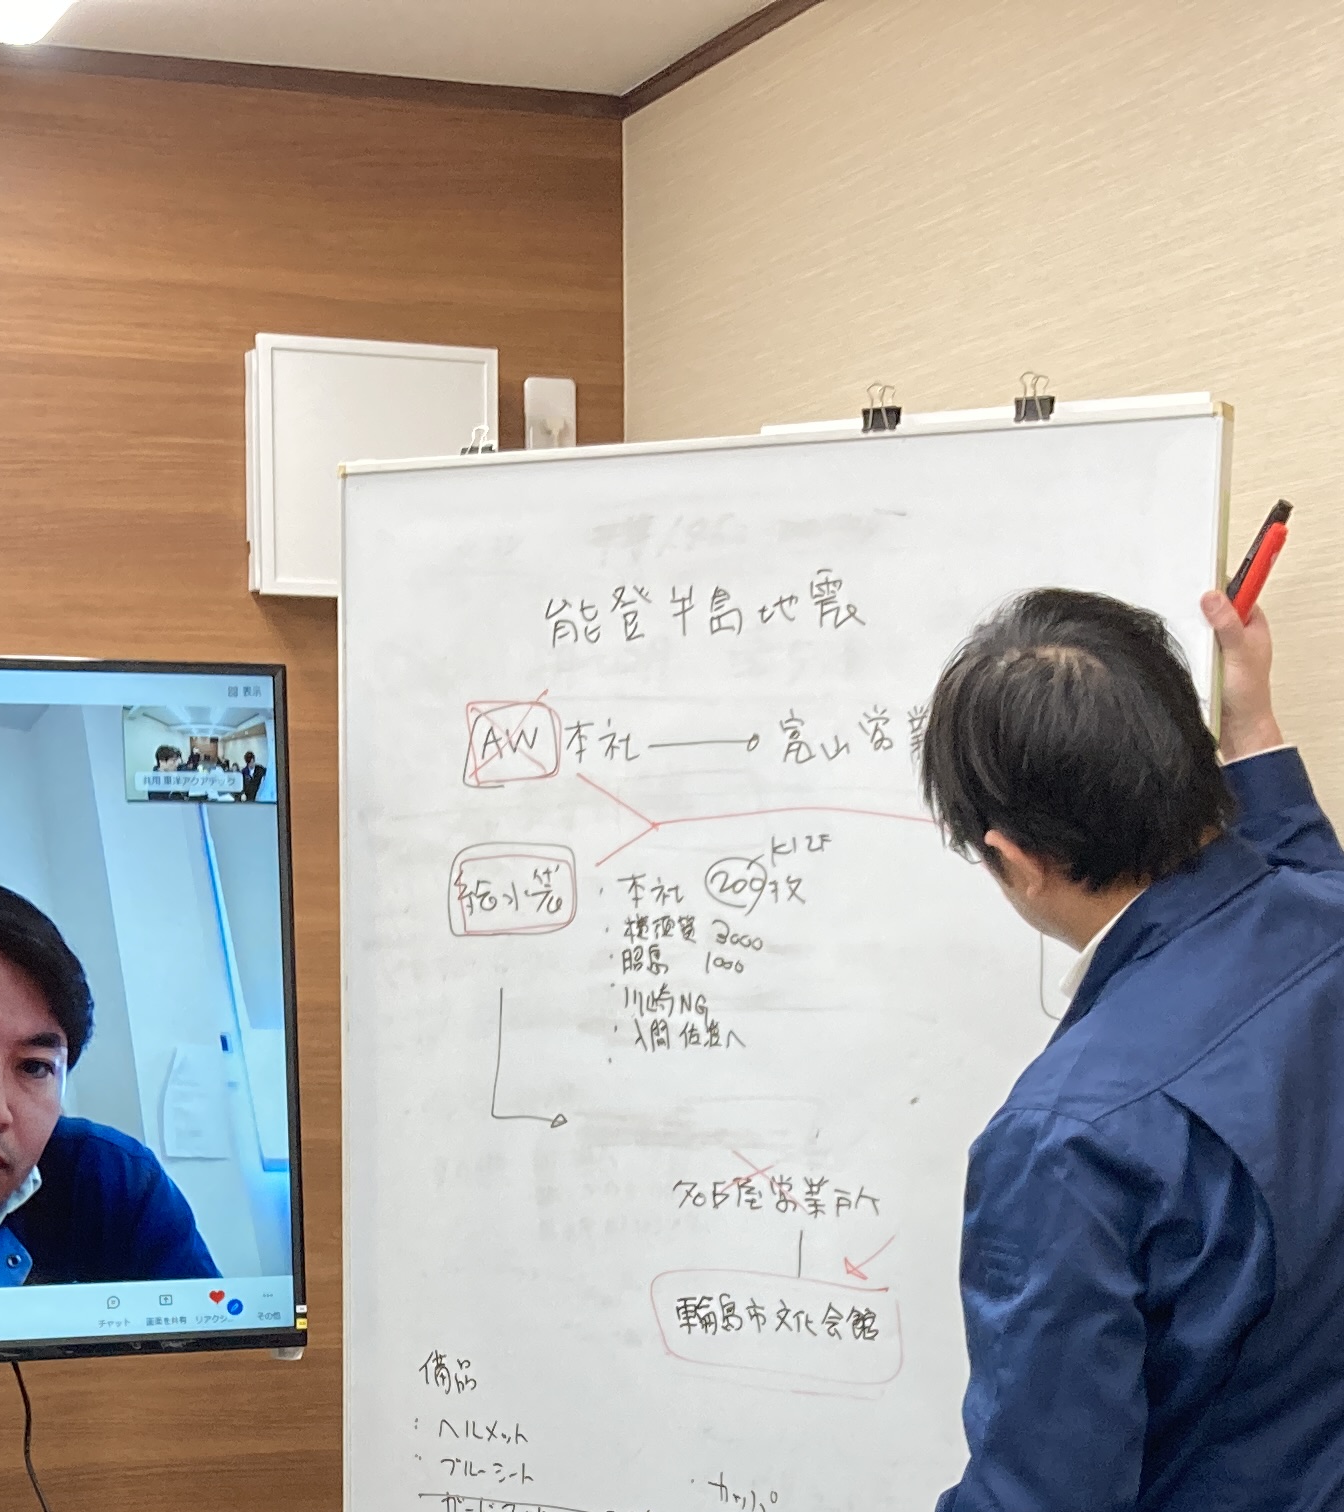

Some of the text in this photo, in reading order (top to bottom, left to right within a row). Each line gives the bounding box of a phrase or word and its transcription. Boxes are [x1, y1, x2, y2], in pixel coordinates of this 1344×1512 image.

[544, 567, 867, 650] 能登半島地震
[480, 725, 539, 761] AW
[564, 717, 642, 764] 本社
[619, 872, 685, 908] 本社
[711, 919, 764, 951] 3000
[704, 951, 745, 974] 1000
[623, 982, 675, 1018] 川崎
[97, 1317, 131, 1329] チャット
[256, 1311, 282, 1321] その他
[675, 1292, 880, 1342] 輪島市文化会館
[418, 1348, 478, 1395] 備品
[437, 1418, 529, 1446] ヘルメット
[439, 1456, 534, 1485] ブルーシート
